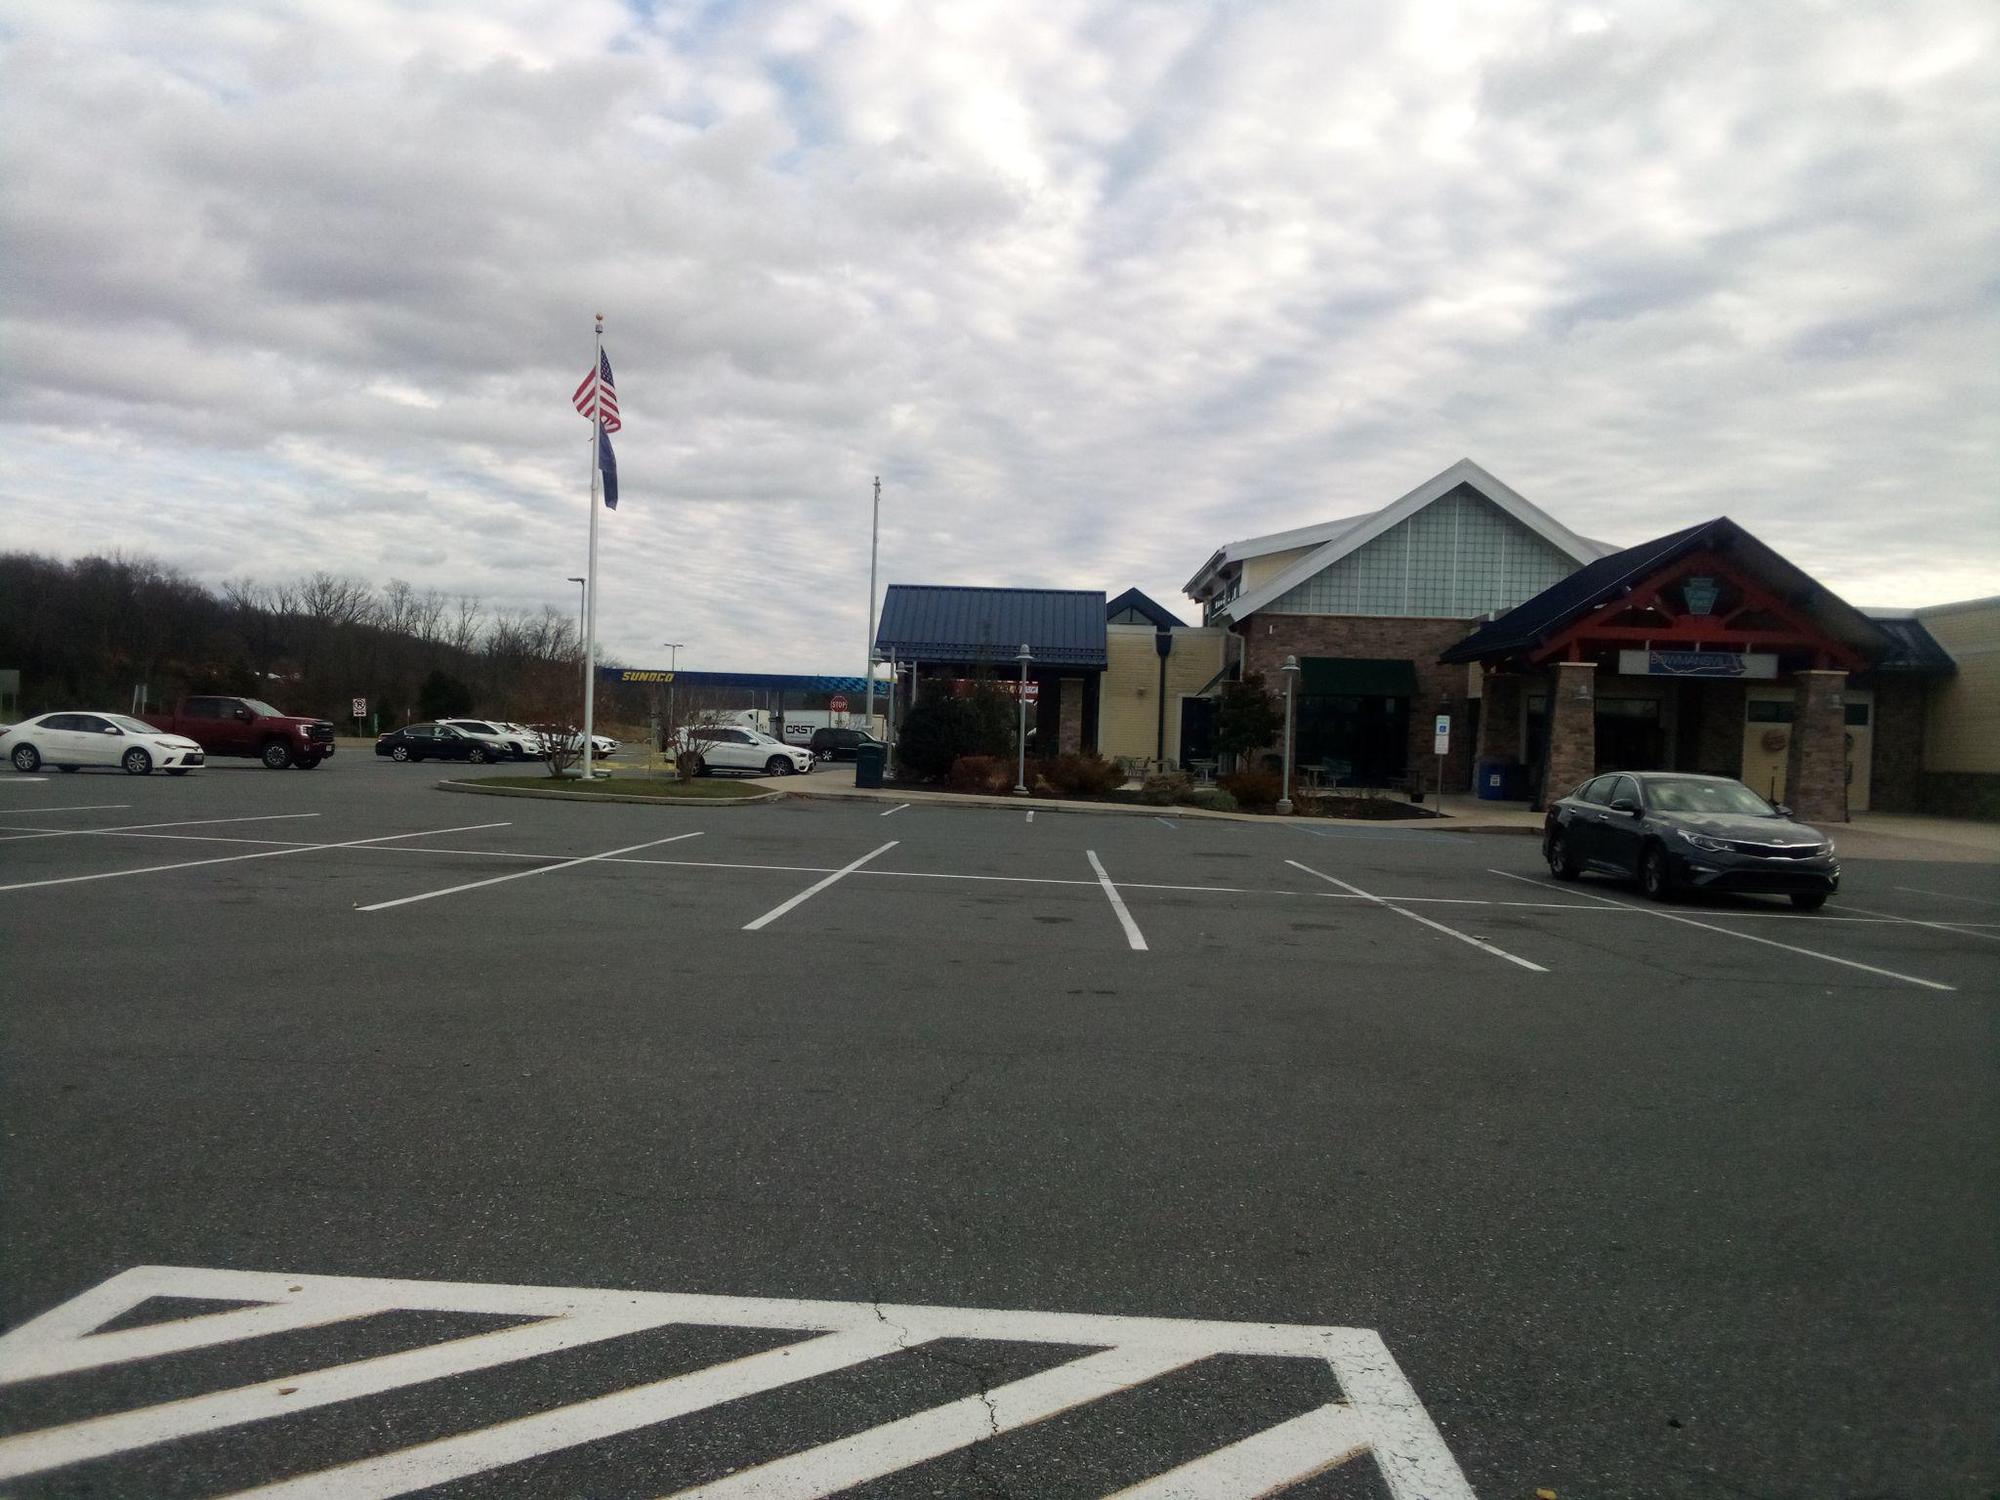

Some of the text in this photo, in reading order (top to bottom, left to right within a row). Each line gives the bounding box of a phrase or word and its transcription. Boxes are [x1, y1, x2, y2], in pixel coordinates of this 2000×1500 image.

[622, 671, 675, 683] SUNOCO
[832, 701, 846, 709] STOP
[786, 725, 815, 734] CRST
